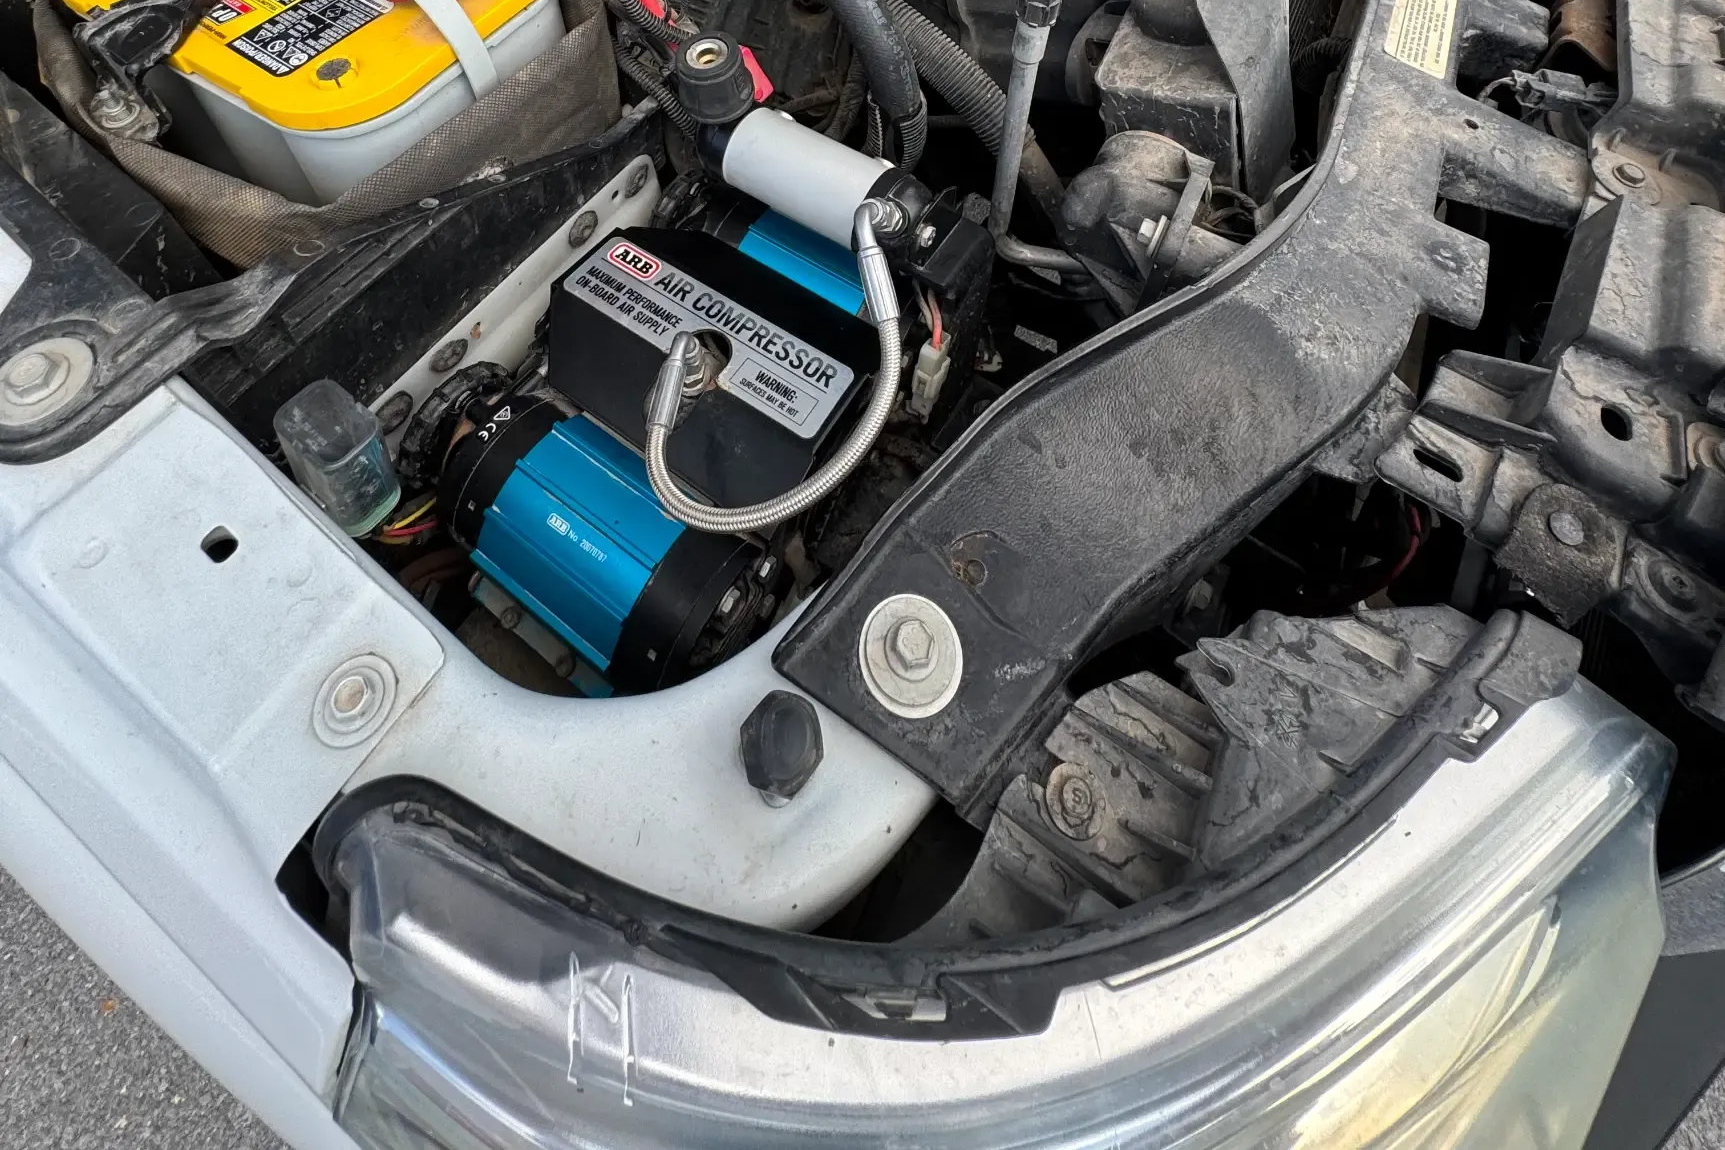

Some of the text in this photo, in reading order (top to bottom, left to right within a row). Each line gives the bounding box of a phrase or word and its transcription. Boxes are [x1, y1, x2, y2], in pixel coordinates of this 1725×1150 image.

[614, 248, 654, 276] ARB
[575, 276, 671, 337] ON-BOARD AIR SUPPLY
[586, 266, 683, 328] MAXIMUM PERFORMANCE
[654, 272, 838, 389] AIR COMPRESSOR
[739, 377, 799, 418] SURFACES MAY BE HOT
[755, 370, 799, 403] WARNING:
[549, 515, 569, 534] ARB
